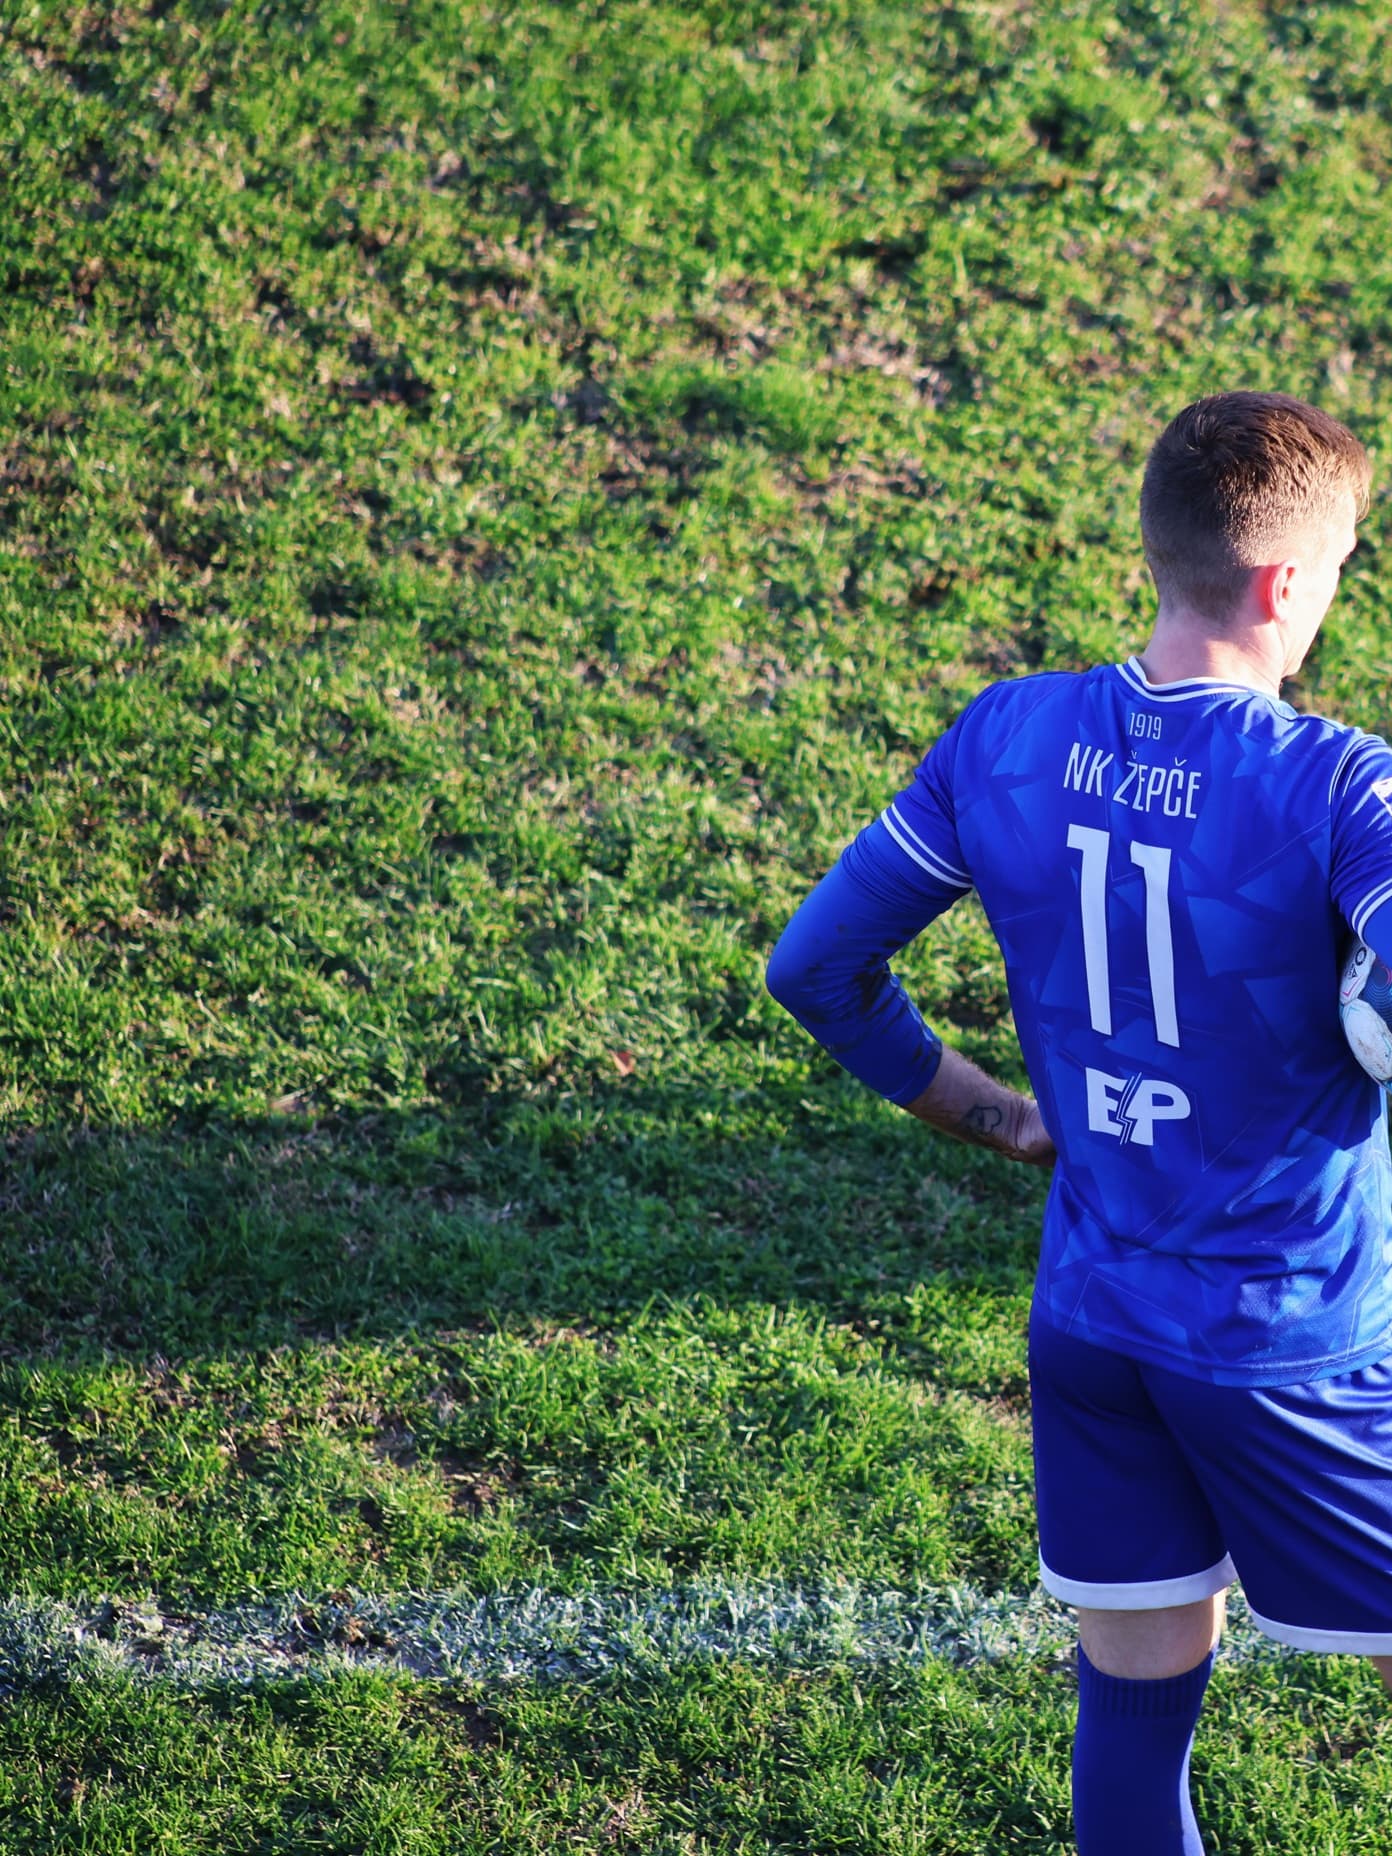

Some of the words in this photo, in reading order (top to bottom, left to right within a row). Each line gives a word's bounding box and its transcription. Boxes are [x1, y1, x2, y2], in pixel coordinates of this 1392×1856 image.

[1129, 712, 1162, 740] 1919
[1063, 742, 1114, 797] NK
[1112, 750, 1202, 819] ŽEPČE
[1066, 823, 1180, 1048] 11
[1086, 1067, 1191, 1146] EP
